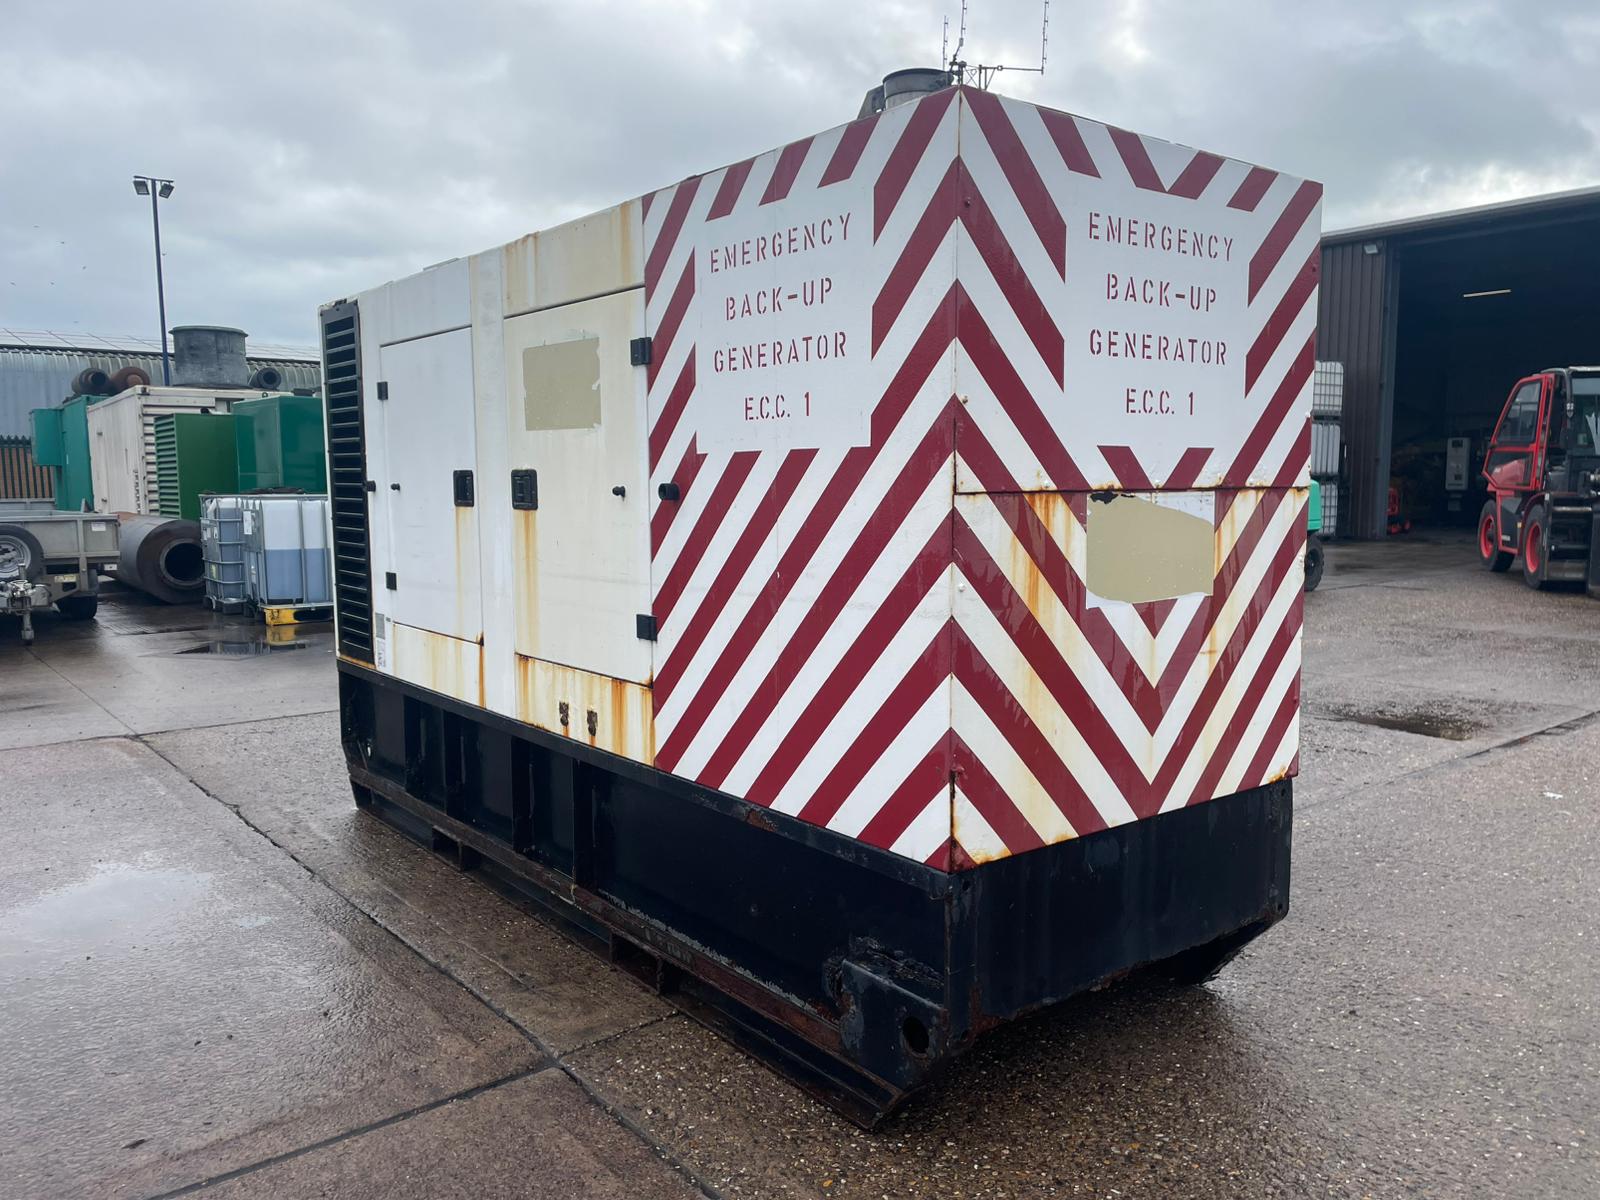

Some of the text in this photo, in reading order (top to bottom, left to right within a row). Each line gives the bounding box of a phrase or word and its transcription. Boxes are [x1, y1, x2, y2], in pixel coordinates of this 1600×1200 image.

[711, 212, 851, 273] EMERGENCY
[1089, 211, 1234, 262] EMERGENCY
[726, 277, 832, 321] BACK-UP
[1106, 273, 1217, 313] BACK-UP
[714, 331, 847, 373] GENERATOR
[1089, 328, 1227, 366] GENERATOR
[744, 391, 811, 421] E.C.C. 1
[1126, 387, 1195, 416] E.C.C. 1
